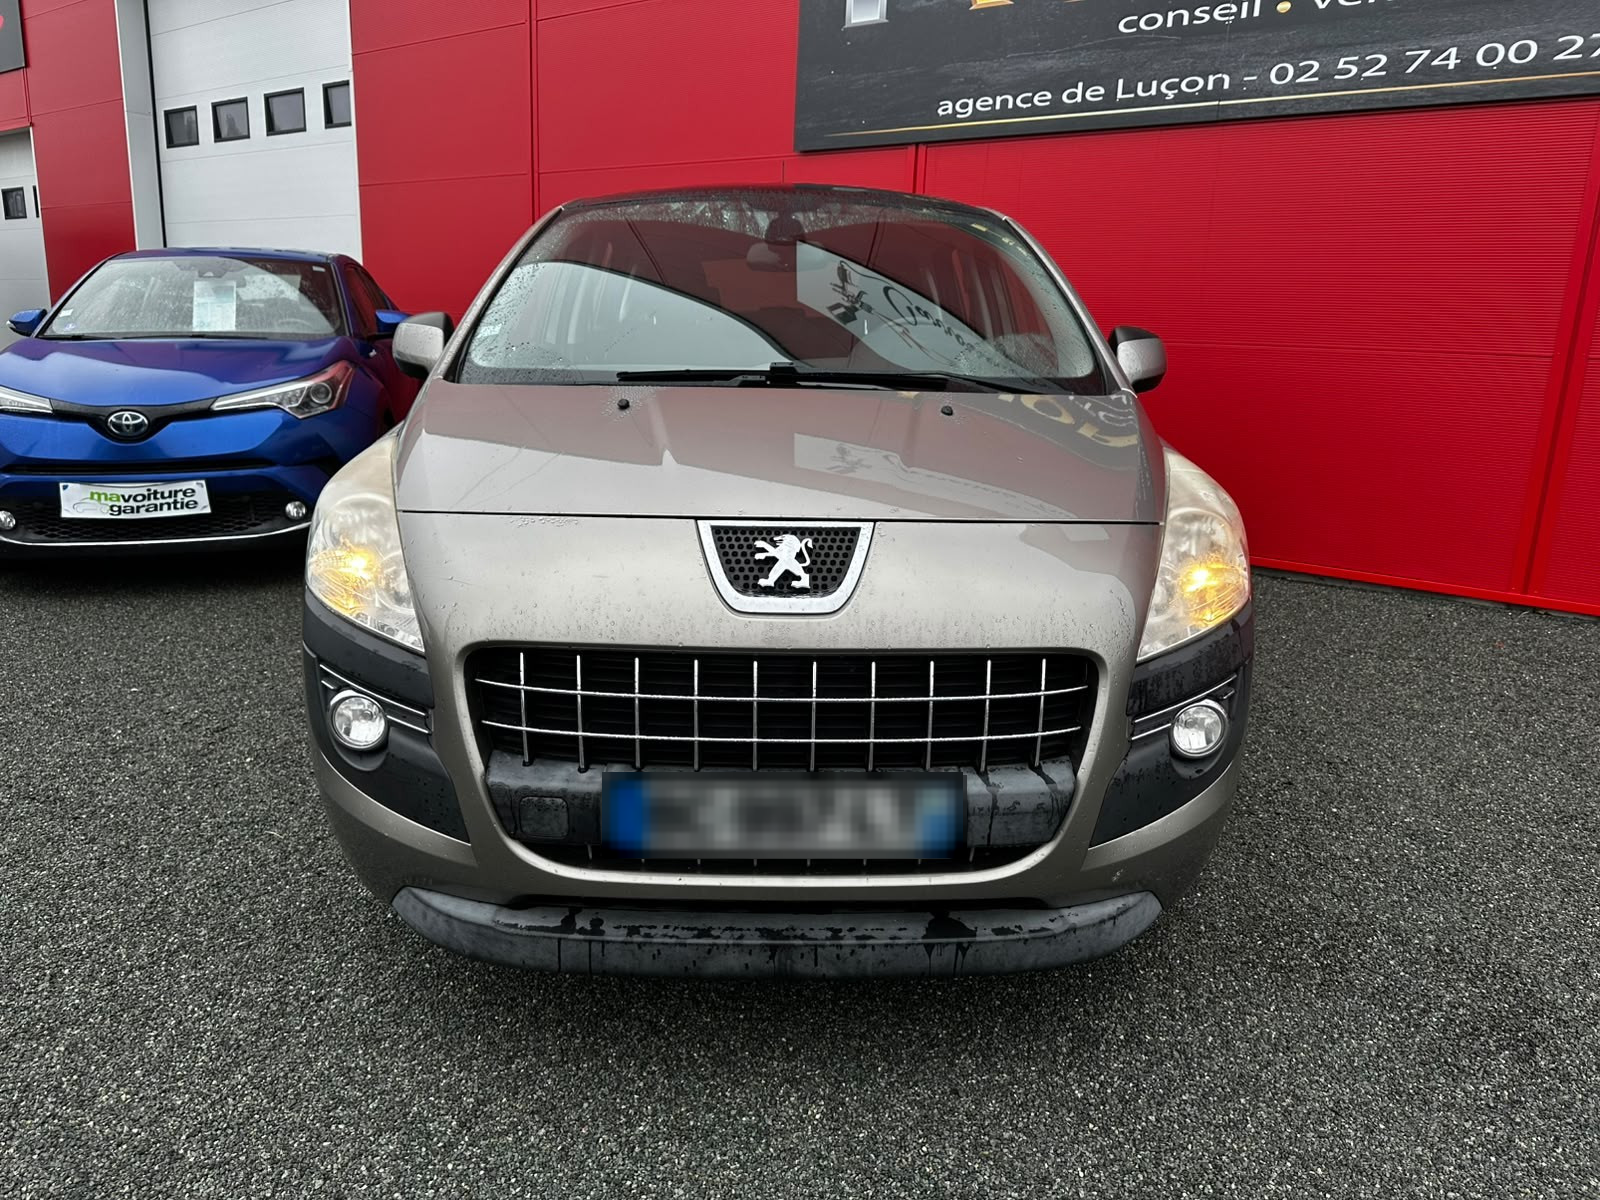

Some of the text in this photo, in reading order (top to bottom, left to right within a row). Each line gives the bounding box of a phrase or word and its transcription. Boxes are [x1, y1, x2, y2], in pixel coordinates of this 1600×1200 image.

[1118, 0, 1261, 33] conseil
[937, 90, 1052, 119] agence
[1061, 81, 1105, 104] de
[1116, 73, 1231, 101] Luçon
[1269, 60, 1320, 85] 02
[1334, 53, 1388, 80] 52
[1405, 46, 1462, 74] 74
[1475, 39, 1538, 68] 00
[109, 498, 199, 516] garantie
